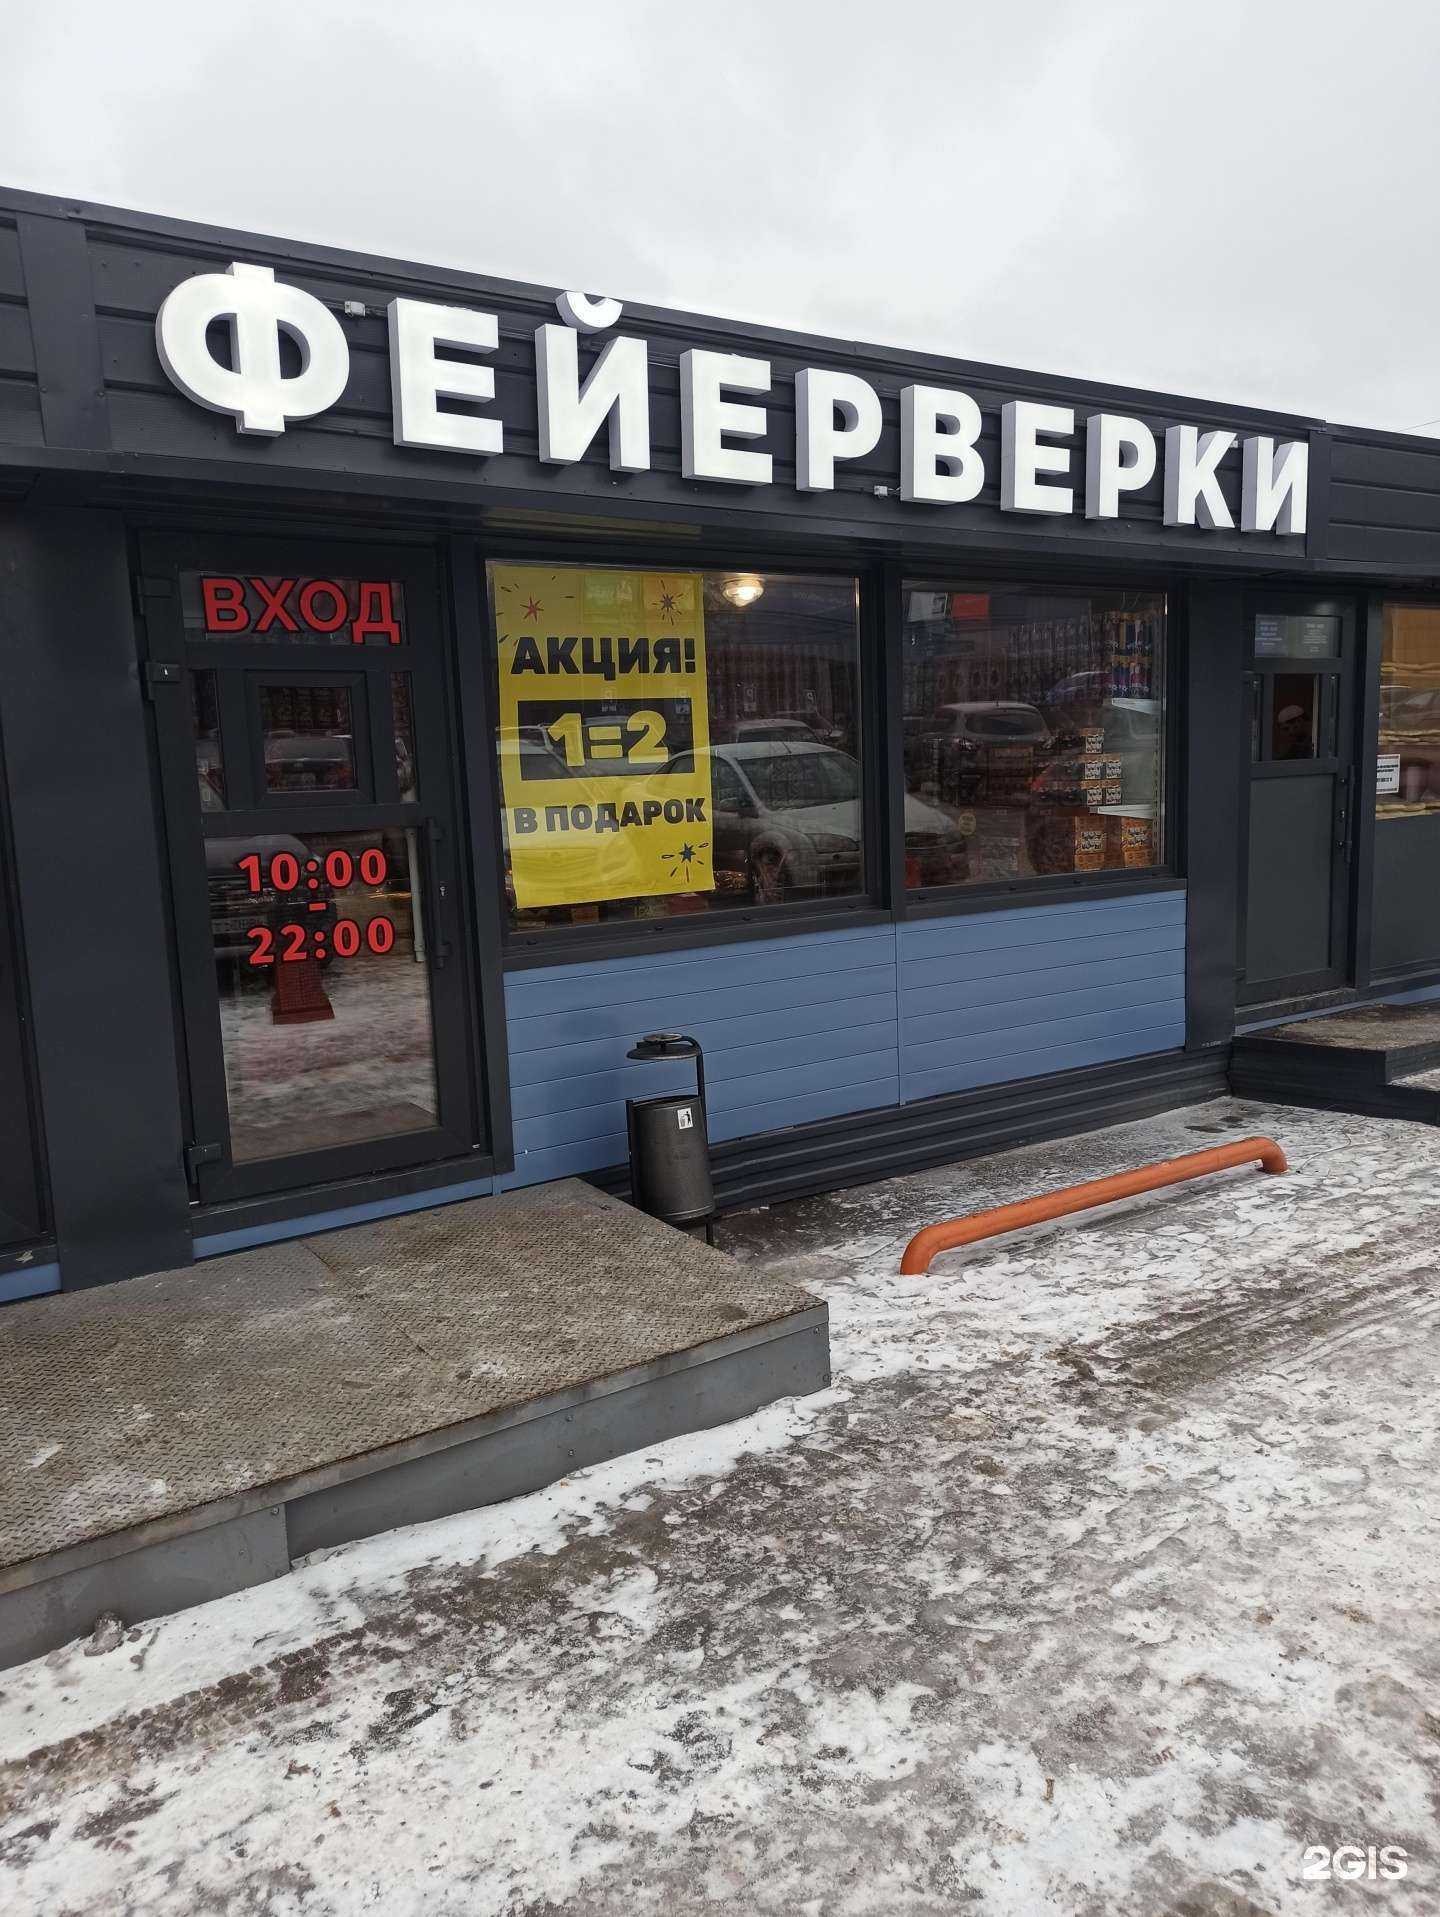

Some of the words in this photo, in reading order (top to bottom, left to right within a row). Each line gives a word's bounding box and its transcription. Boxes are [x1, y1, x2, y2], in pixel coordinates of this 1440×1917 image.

[155, 262, 1309, 536] ФЕЙЕРВЕРКИ
[202, 576, 401, 645] ВХОД
[510, 636, 697, 681] АКЦИЯ!
[547, 710, 669, 767] 1=2
[513, 807, 539, 834] В
[544, 797, 707, 834] ПОДАРОК
[238, 848, 387, 892] 10:00
[247, 916, 395, 965] 22:00
